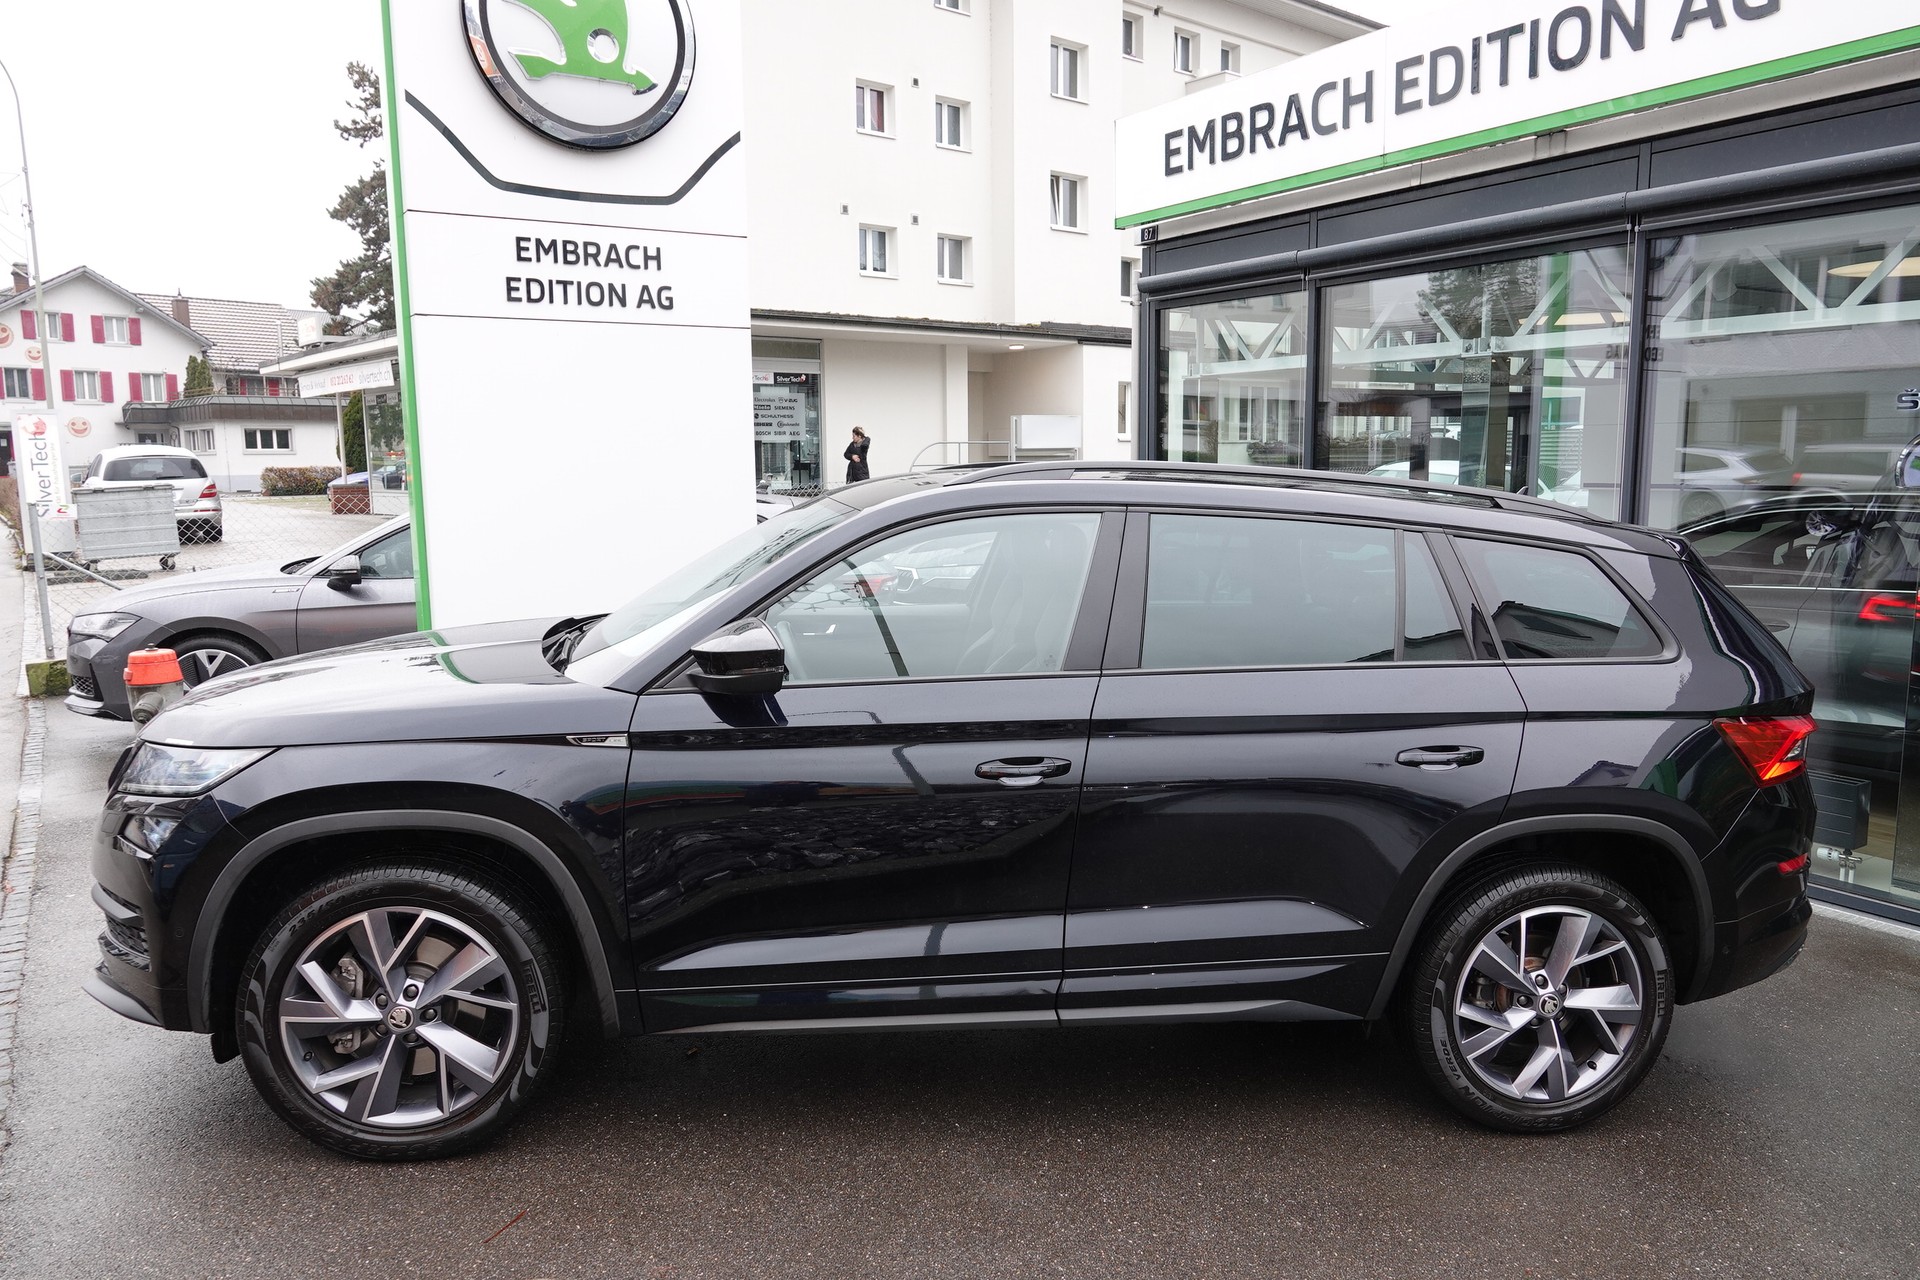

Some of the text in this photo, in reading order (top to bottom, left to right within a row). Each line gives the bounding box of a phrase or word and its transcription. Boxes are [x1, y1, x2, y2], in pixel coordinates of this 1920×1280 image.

[1165, 69, 1374, 177] EMBRACH
[1395, 0, 1646, 115] EDITION
[1143, 228, 1153, 240] 87
[515, 236, 663, 271] EMBRACH
[505, 276, 674, 311] EDITION AG
[523, 959, 548, 1016] PIRELLI
